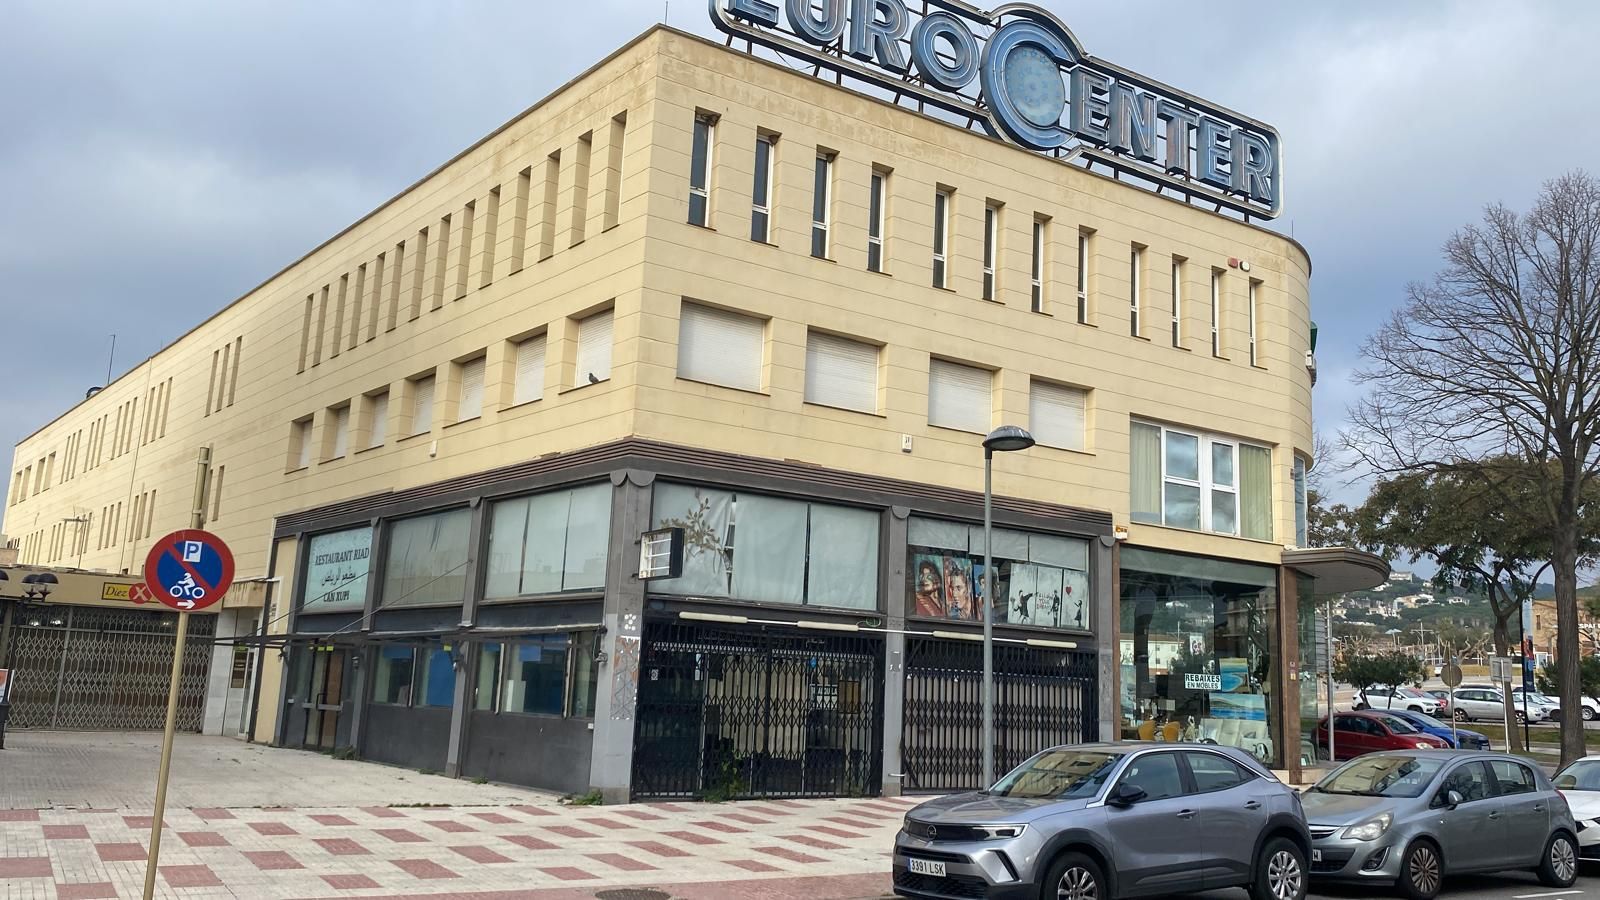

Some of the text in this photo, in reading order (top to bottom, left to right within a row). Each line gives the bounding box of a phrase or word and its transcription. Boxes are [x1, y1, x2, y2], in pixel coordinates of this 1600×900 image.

[185, 542, 200, 560] P
[315, 548, 369, 565] RESTAURANT RIAD
[105, 586, 128, 597] Diez
[912, 860, 944, 875] 3391 LSK
